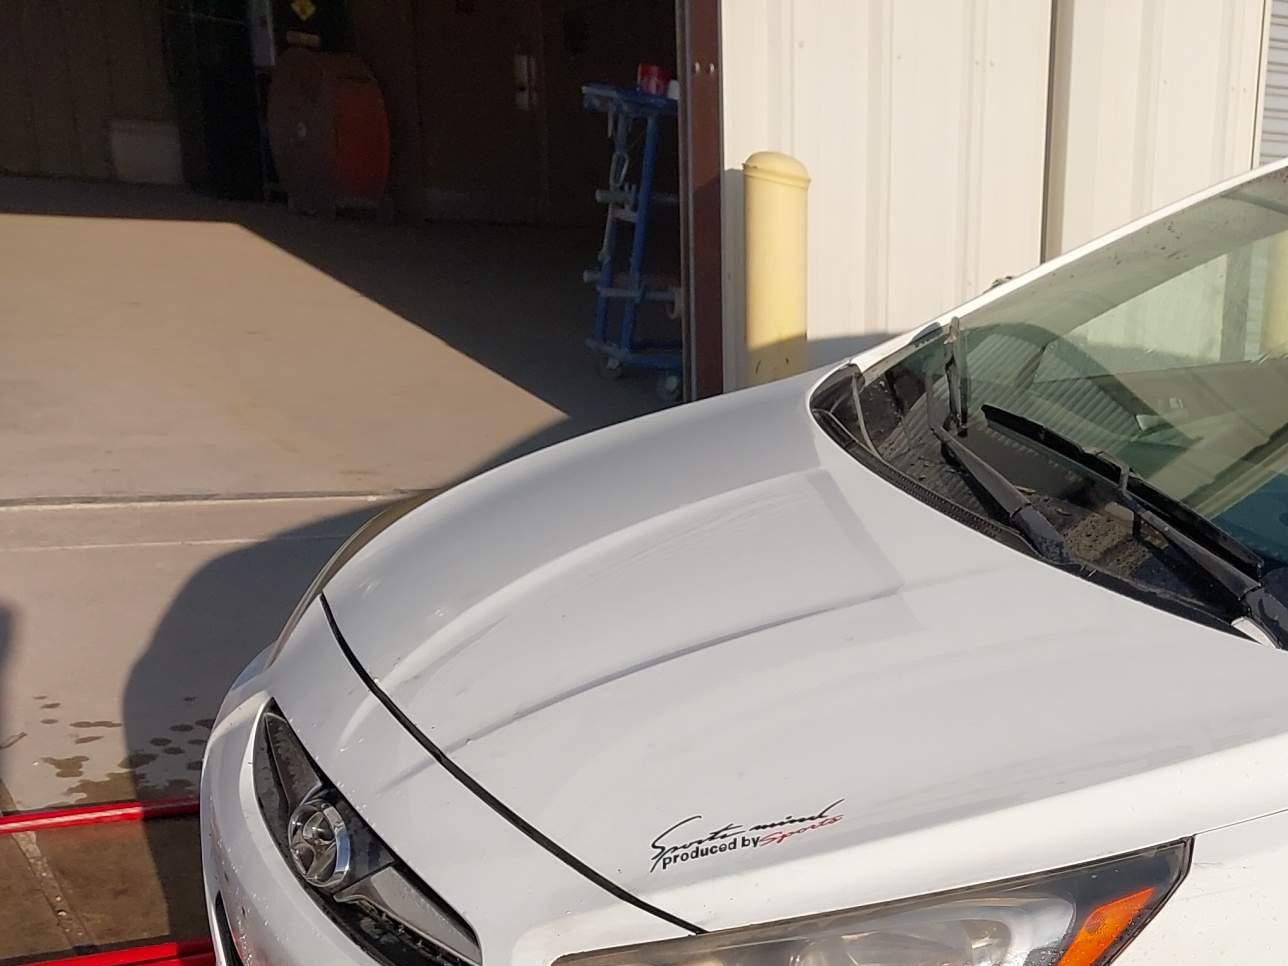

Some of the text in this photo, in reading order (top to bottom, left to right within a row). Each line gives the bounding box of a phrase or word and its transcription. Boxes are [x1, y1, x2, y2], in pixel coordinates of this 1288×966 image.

[661, 815, 845, 869] produced by Sports
